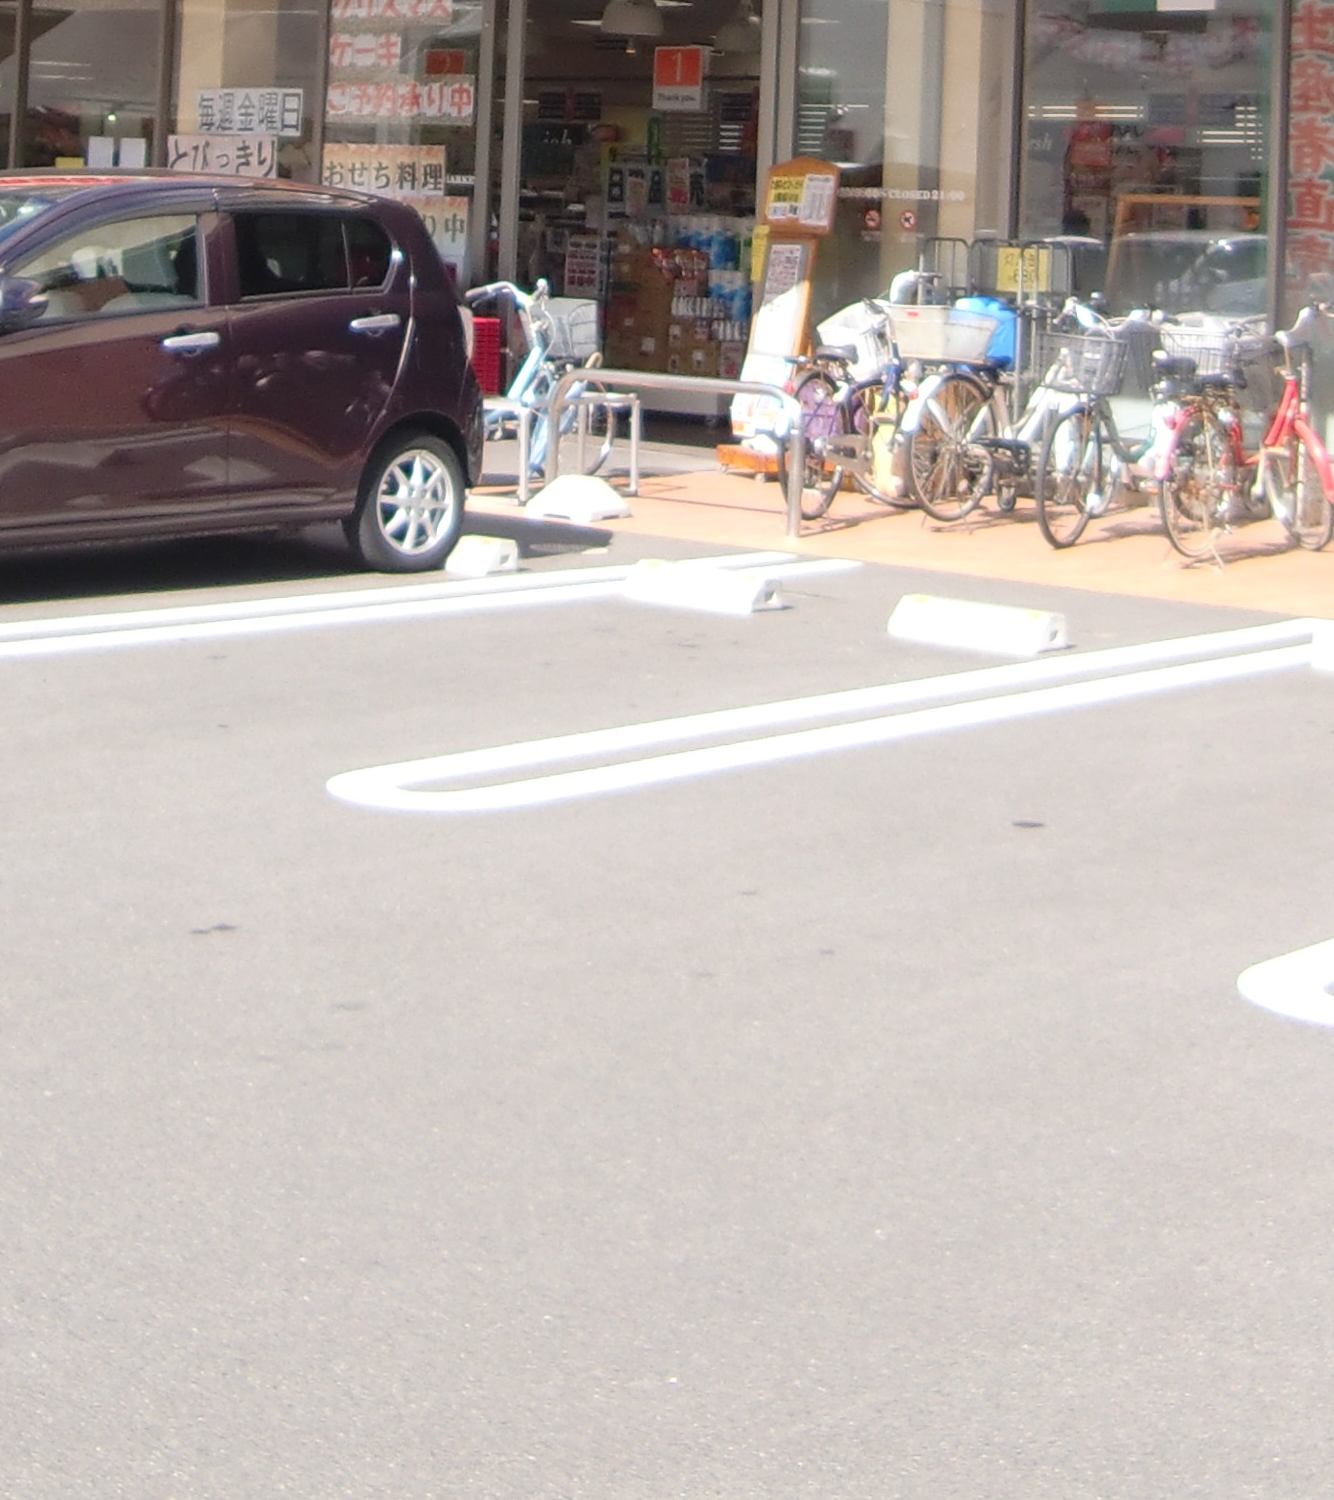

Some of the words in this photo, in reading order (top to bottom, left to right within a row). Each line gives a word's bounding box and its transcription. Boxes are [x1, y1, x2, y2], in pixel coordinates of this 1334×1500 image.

[330, 34, 399, 67] ケーキ
[198, 91, 301, 132] 毎週金曜日
[327, 80, 473, 116] ご予約承り中
[323, 160, 443, 191] おせち料理
